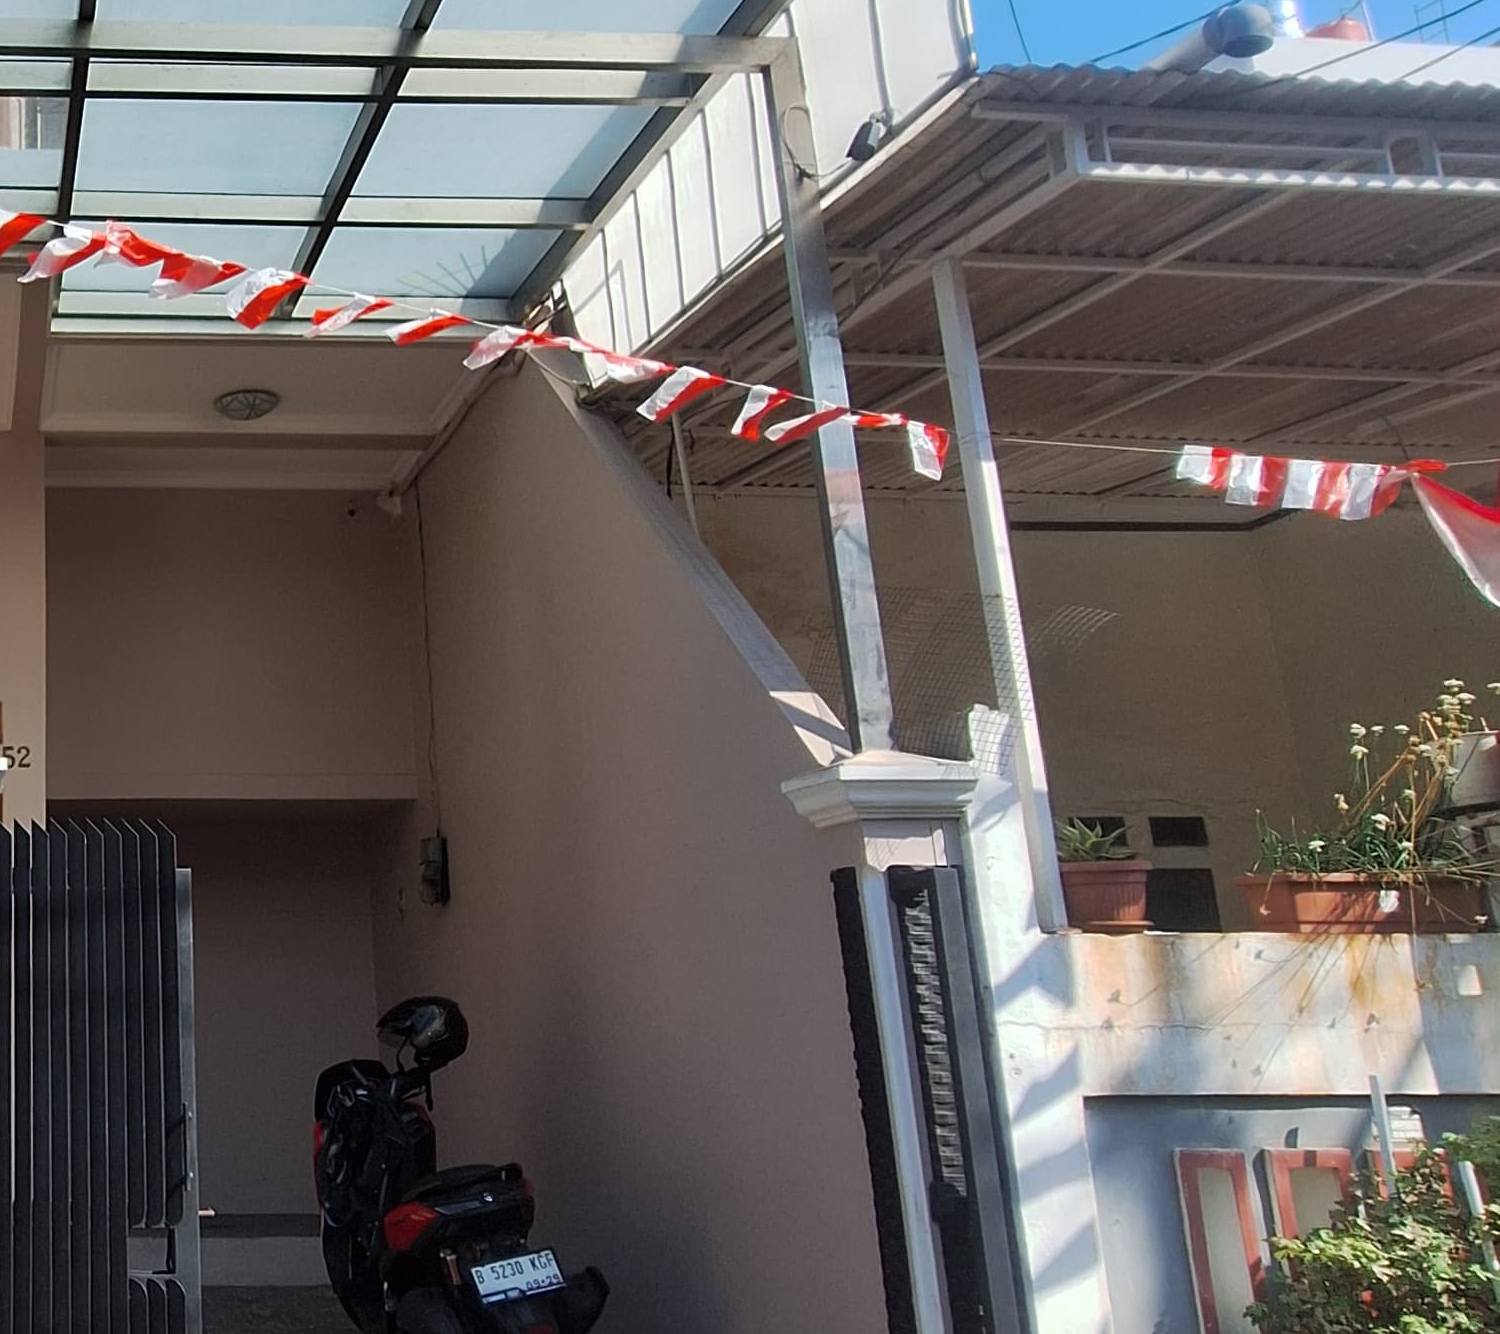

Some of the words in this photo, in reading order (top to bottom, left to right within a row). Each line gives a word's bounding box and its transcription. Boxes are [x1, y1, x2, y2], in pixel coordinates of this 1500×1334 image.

[2, 746, 31, 769] 52
[475, 1270, 485, 1284] B
[490, 1261, 524, 1280] 5230
